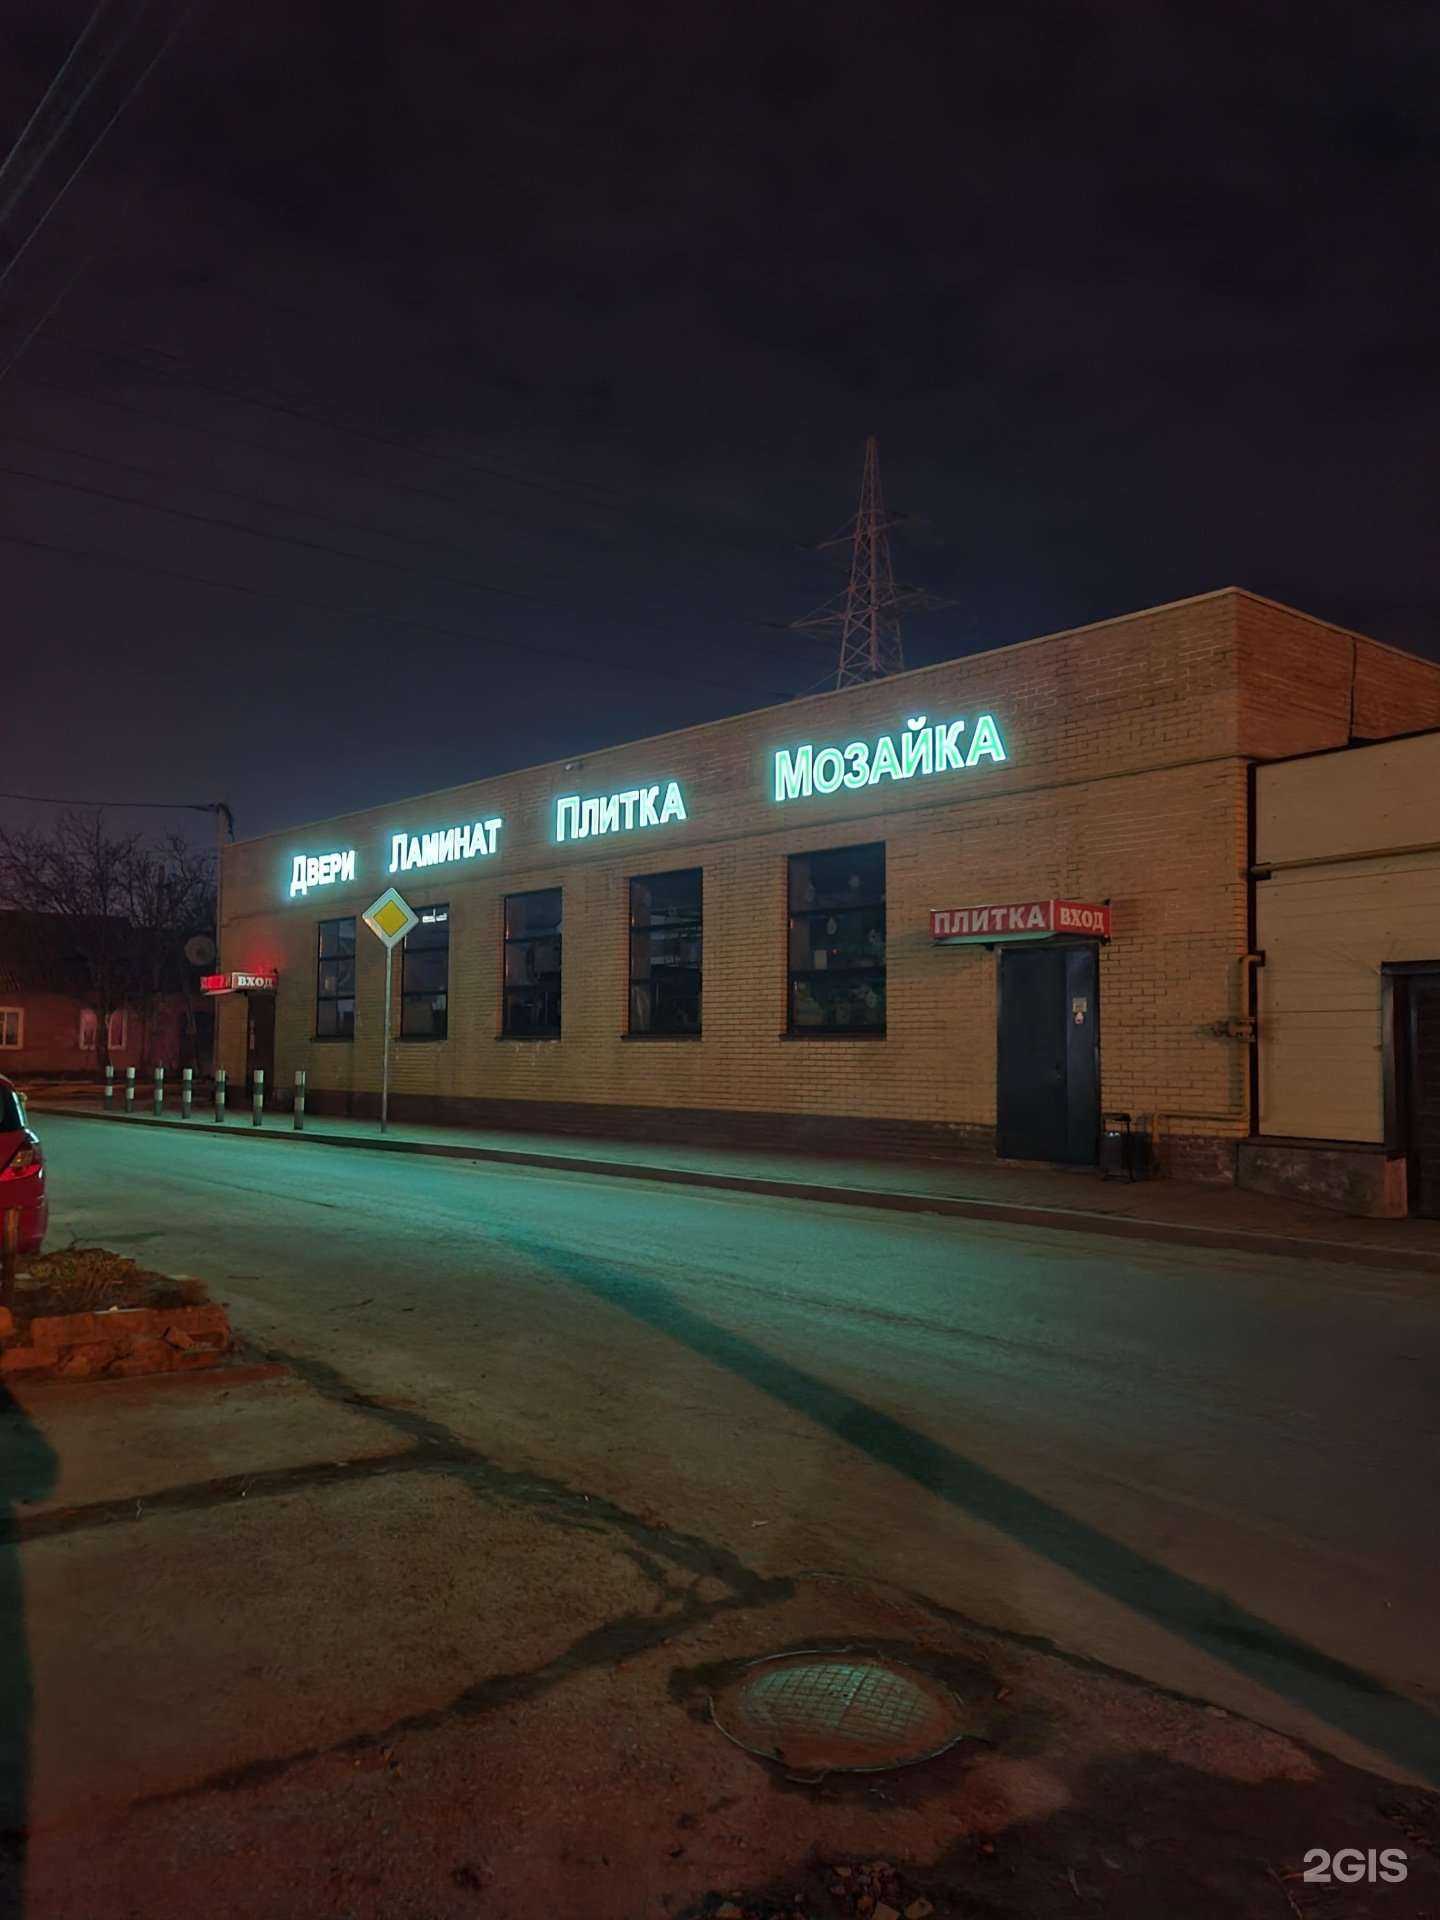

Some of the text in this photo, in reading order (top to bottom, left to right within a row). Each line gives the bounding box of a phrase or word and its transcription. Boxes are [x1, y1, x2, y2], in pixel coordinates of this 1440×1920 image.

[556, 782, 687, 842] ПЛИТКА
[934, 905, 1046, 935] ПЛИТКА
[1060, 907, 1104, 931] ВХОД
[237, 976, 273, 989] ВХОД
